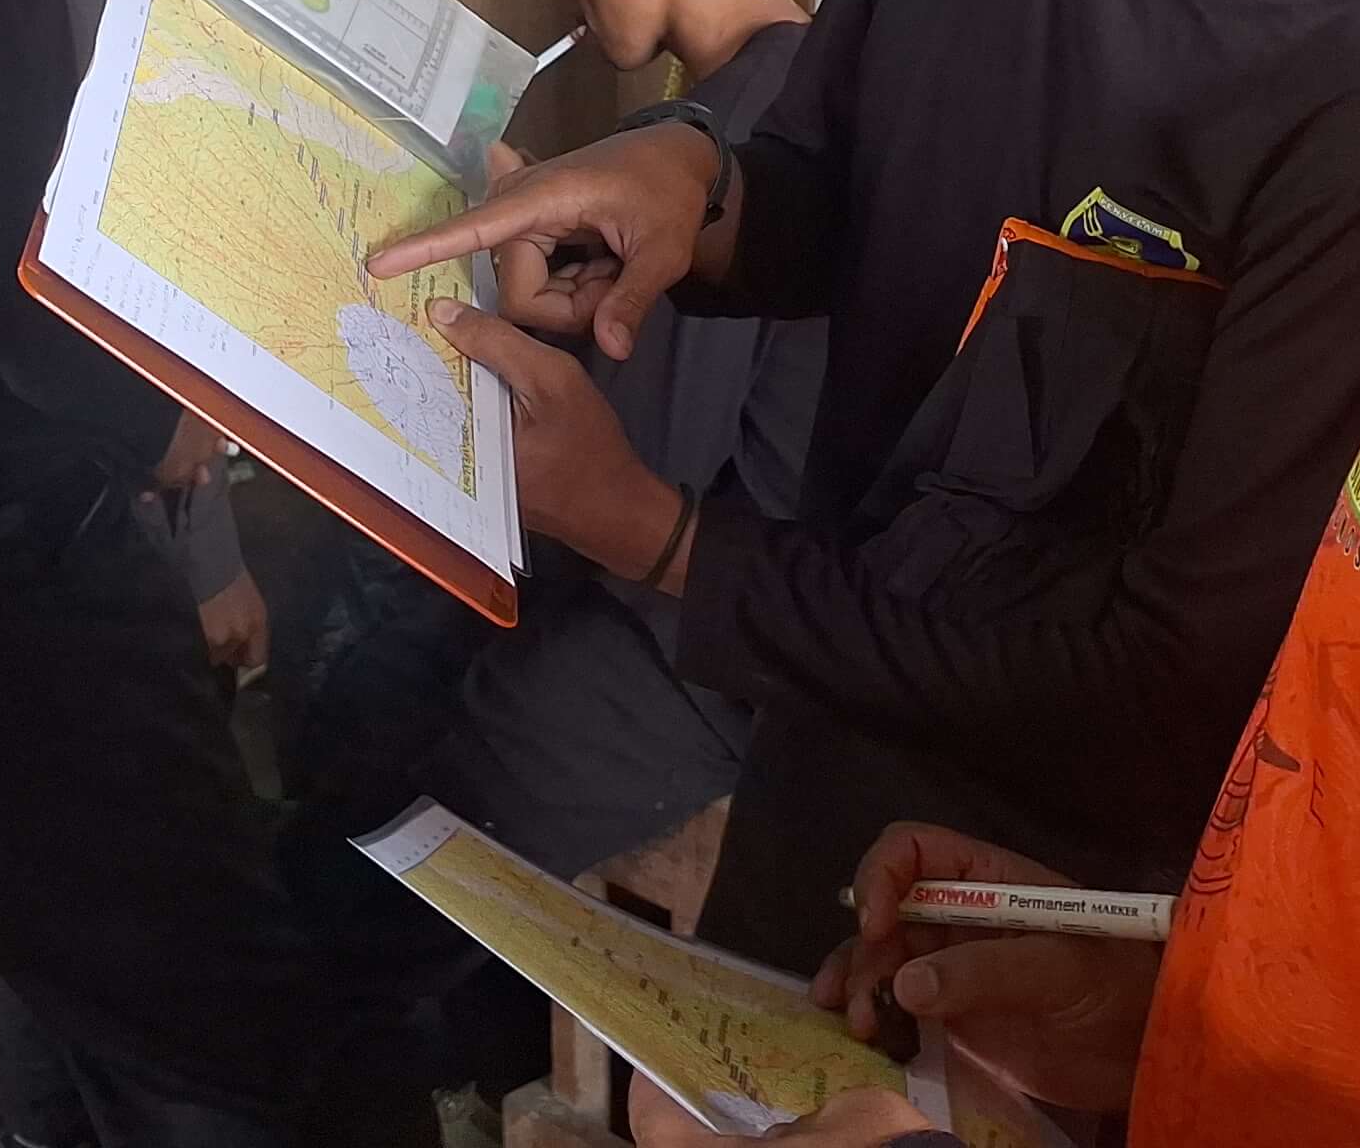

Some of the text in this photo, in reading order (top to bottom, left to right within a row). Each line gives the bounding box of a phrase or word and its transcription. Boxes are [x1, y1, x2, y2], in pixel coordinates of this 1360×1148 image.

[914, 886, 1140, 919] SNOWMAN Permanent MARKER
